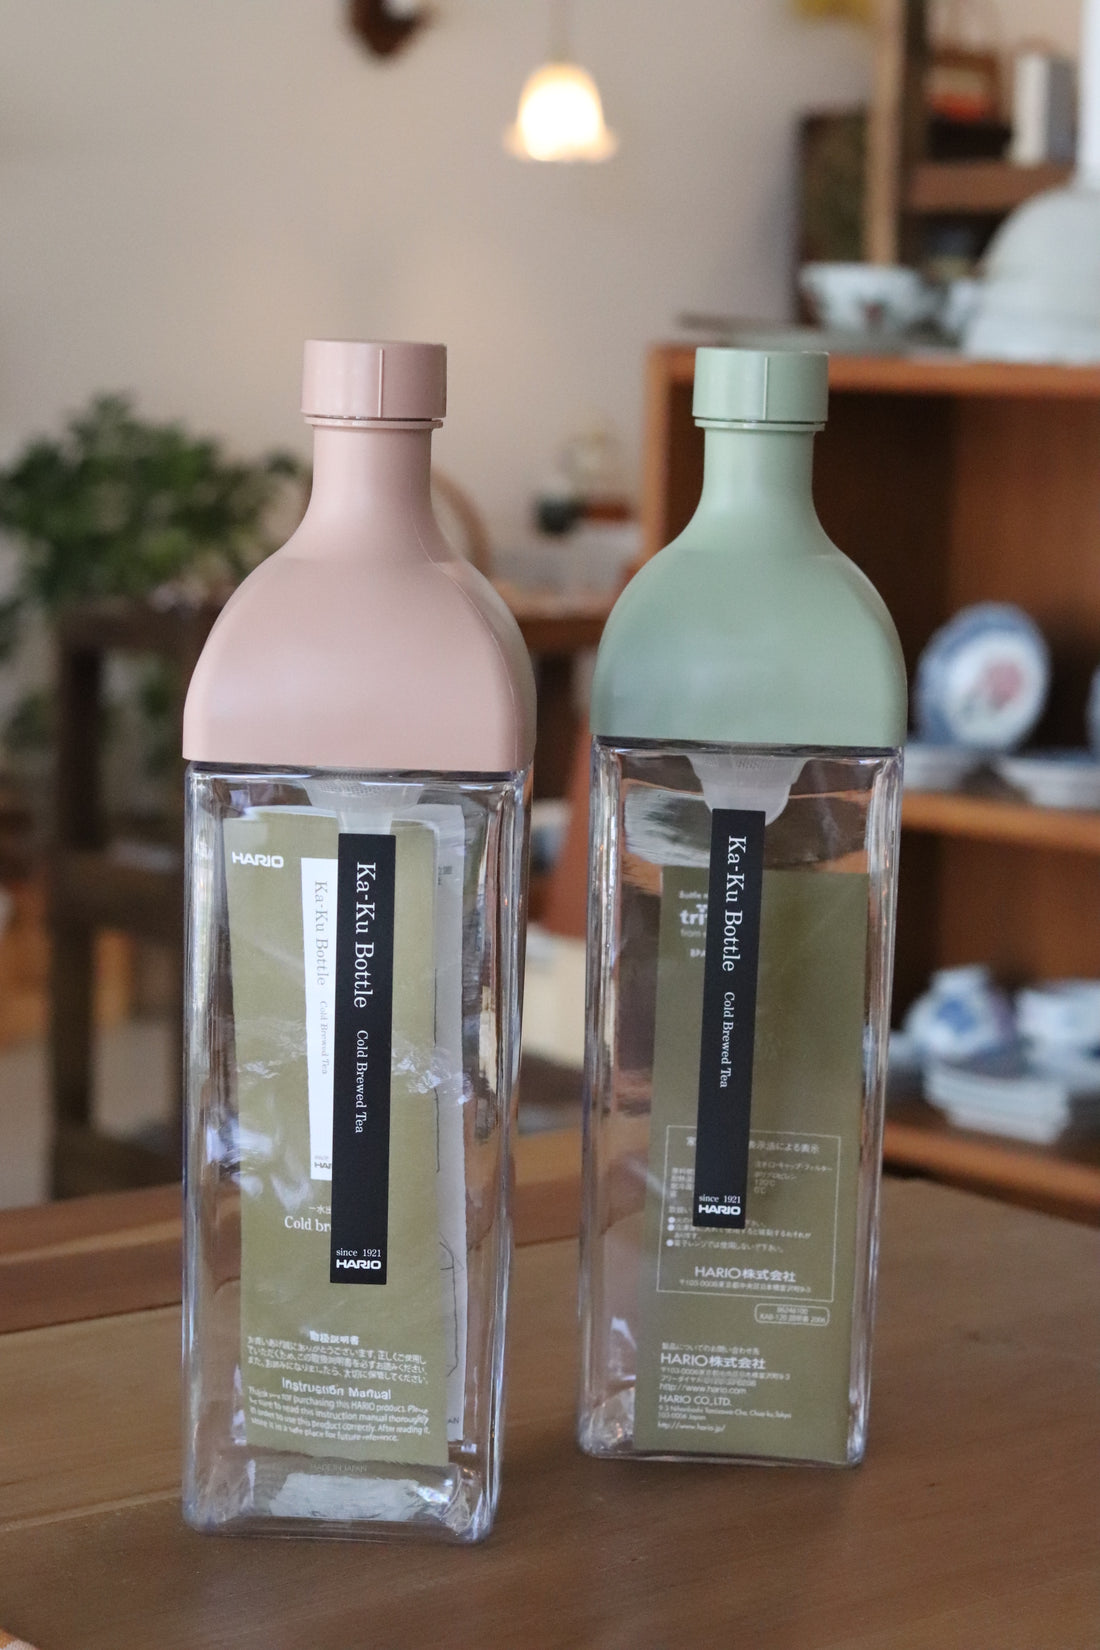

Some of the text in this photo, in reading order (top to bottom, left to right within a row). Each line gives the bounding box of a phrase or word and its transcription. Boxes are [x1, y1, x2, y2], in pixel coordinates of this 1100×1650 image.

[231, 851, 284, 869] HARIO
[314, 880, 329, 933] Ka-Ku
[315, 938, 329, 986] Bottle
[719, 835, 747, 1088] Ka-Ku Bottle Cold Brewed Tea
[353, 861, 376, 1133] Ka-Ku Bottle Cold Brewed Tea
[698, 1193, 741, 1204] since 1921
[698, 1204, 741, 1216] HARIO
[284, 1215, 332, 1232] Cold br
[336, 1247, 382, 1258] since 1921
[336, 1259, 382, 1270] HARIO
[694, 1265, 796, 1283] HARIO株式会社
[660, 1352, 767, 1370] HARIO株式会社
[282, 1377, 391, 1400] Instruction Manual
[293, 1395, 335, 1411] purchasing
[351, 1400, 375, 1411] HARIO
[659, 1394, 692, 1405] HARIO
[315, 1410, 357, 1421] instruction
[359, 1413, 387, 1422] manual
[304, 1428, 325, 1438] place
[337, 1431, 361, 1441] future
[311, 1420, 341, 1430] product
[396, 1426, 423, 1436] reading
